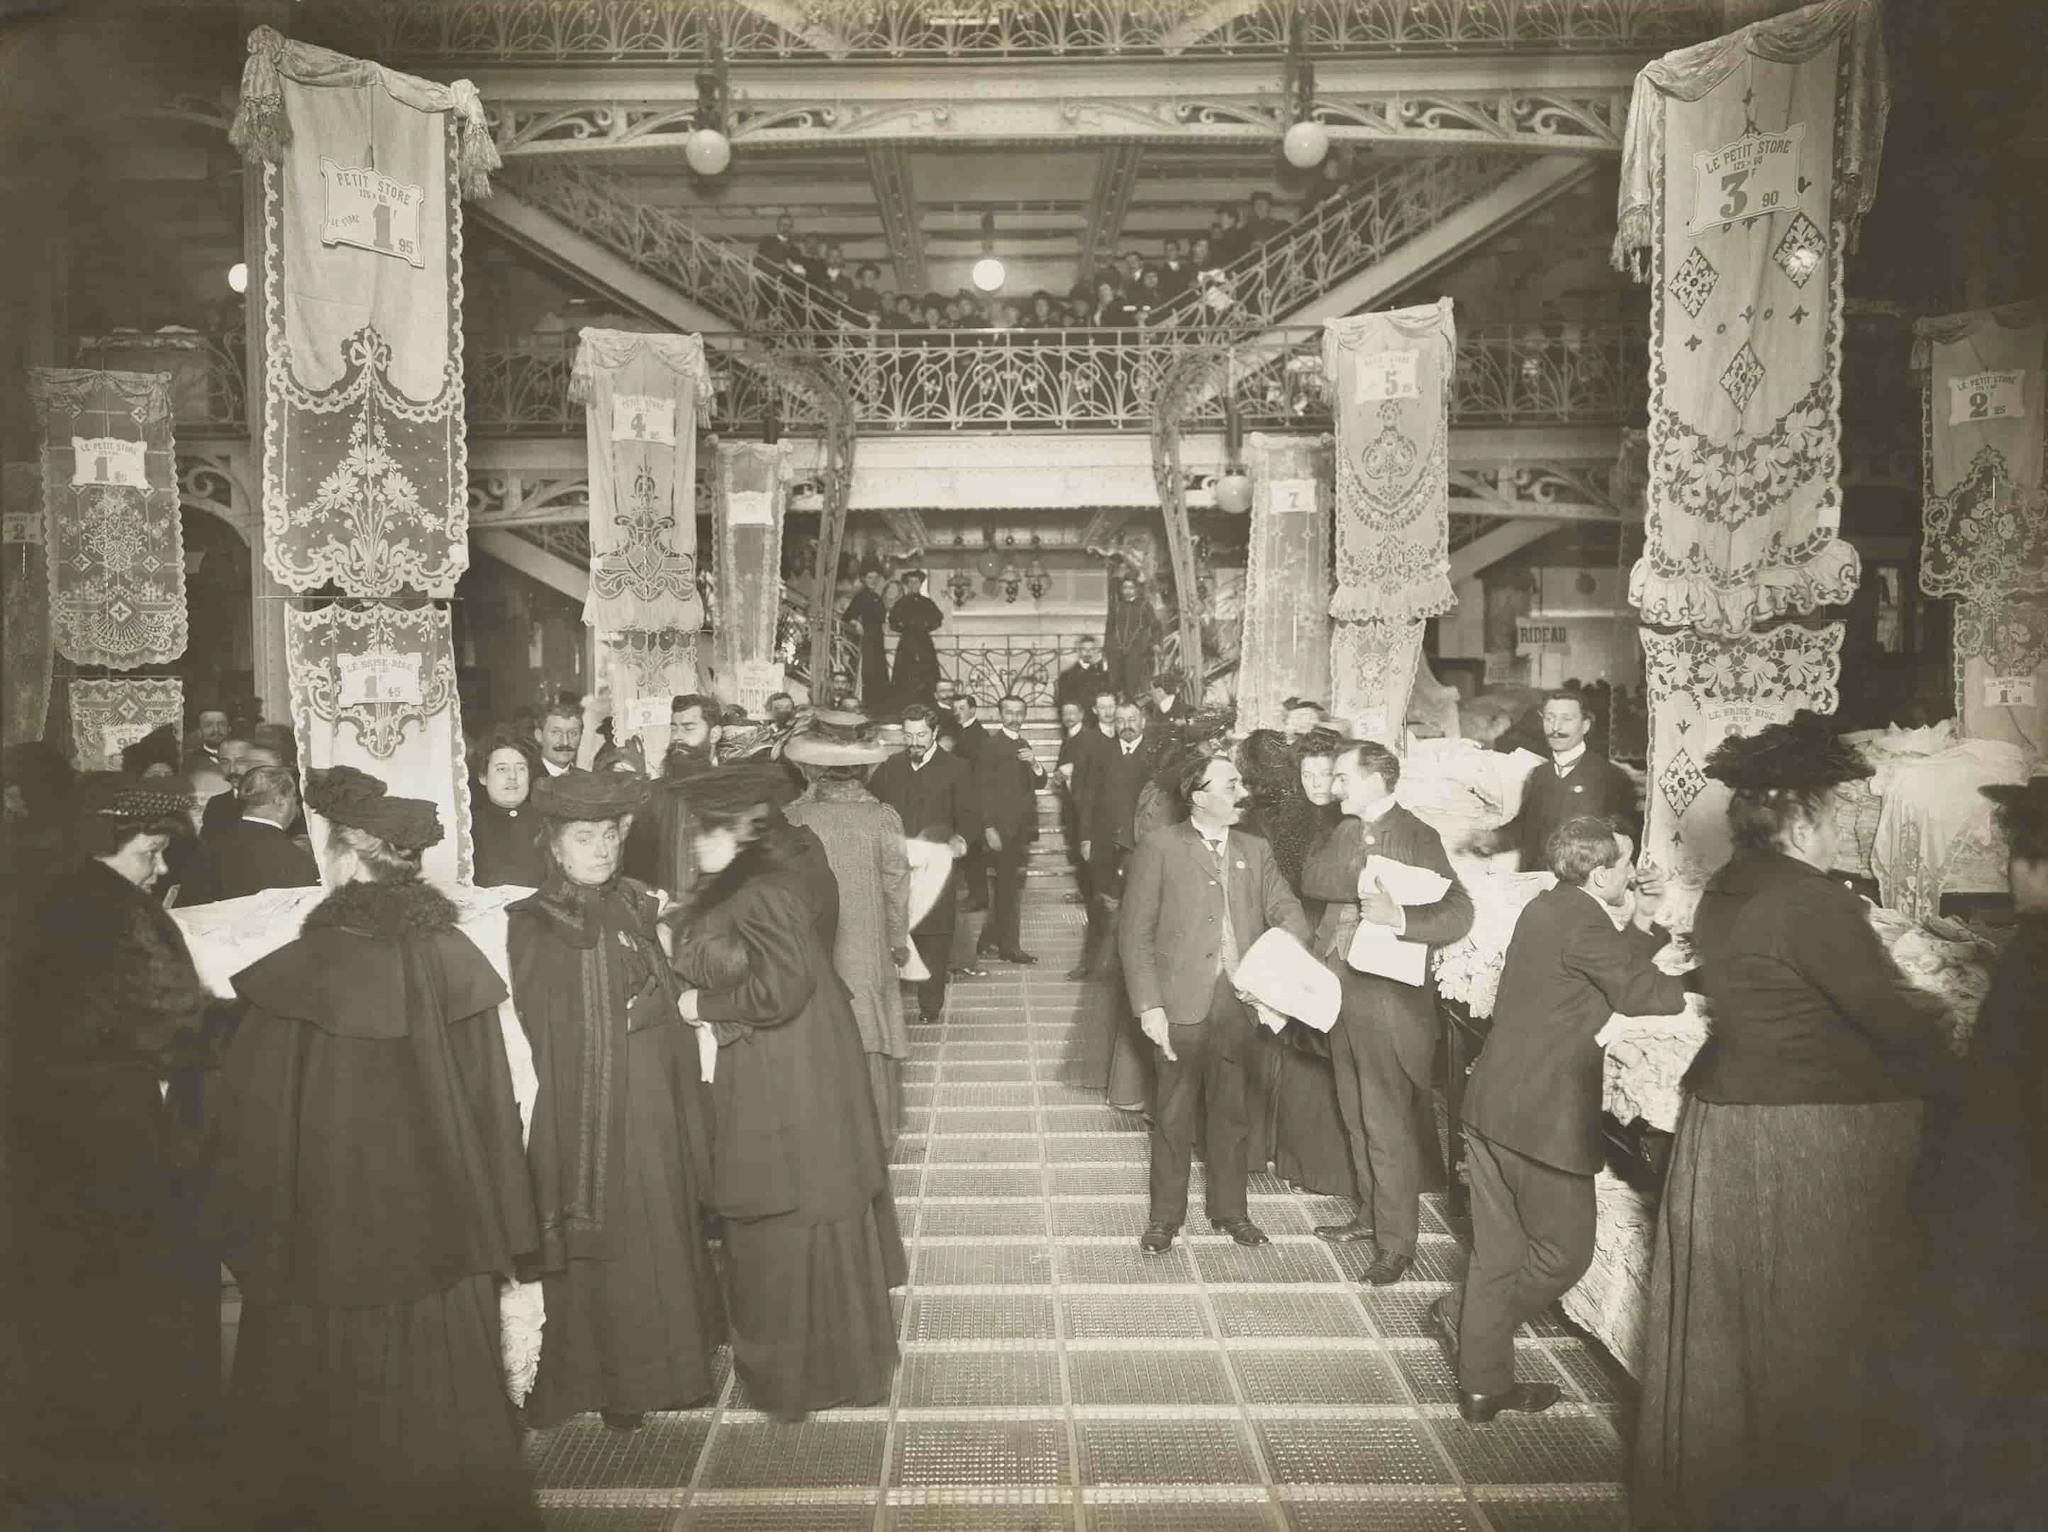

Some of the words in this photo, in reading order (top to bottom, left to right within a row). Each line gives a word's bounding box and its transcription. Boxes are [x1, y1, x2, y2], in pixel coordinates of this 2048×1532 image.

[1705, 157, 1720, 174] LE
[1723, 143, 1752, 164] PETIT
[1757, 139, 1792, 154] STORE
[336, 173, 369, 188] PETIT
[377, 180, 412, 206] STORE
[1719, 169, 1748, 218] 3
[1761, 190, 1779, 208] 90
[373, 204, 394, 252] 1
[398, 238, 414, 255] 95
[1385, 370, 1398, 396] 5
[1969, 392, 1988, 418] 2
[631, 413, 646, 438] 4
[94, 457, 110, 481] 1
[1520, 626, 1566, 644] RIDEAU
[364, 676, 379, 698] 1
[2000, 690, 2009, 703] 1
